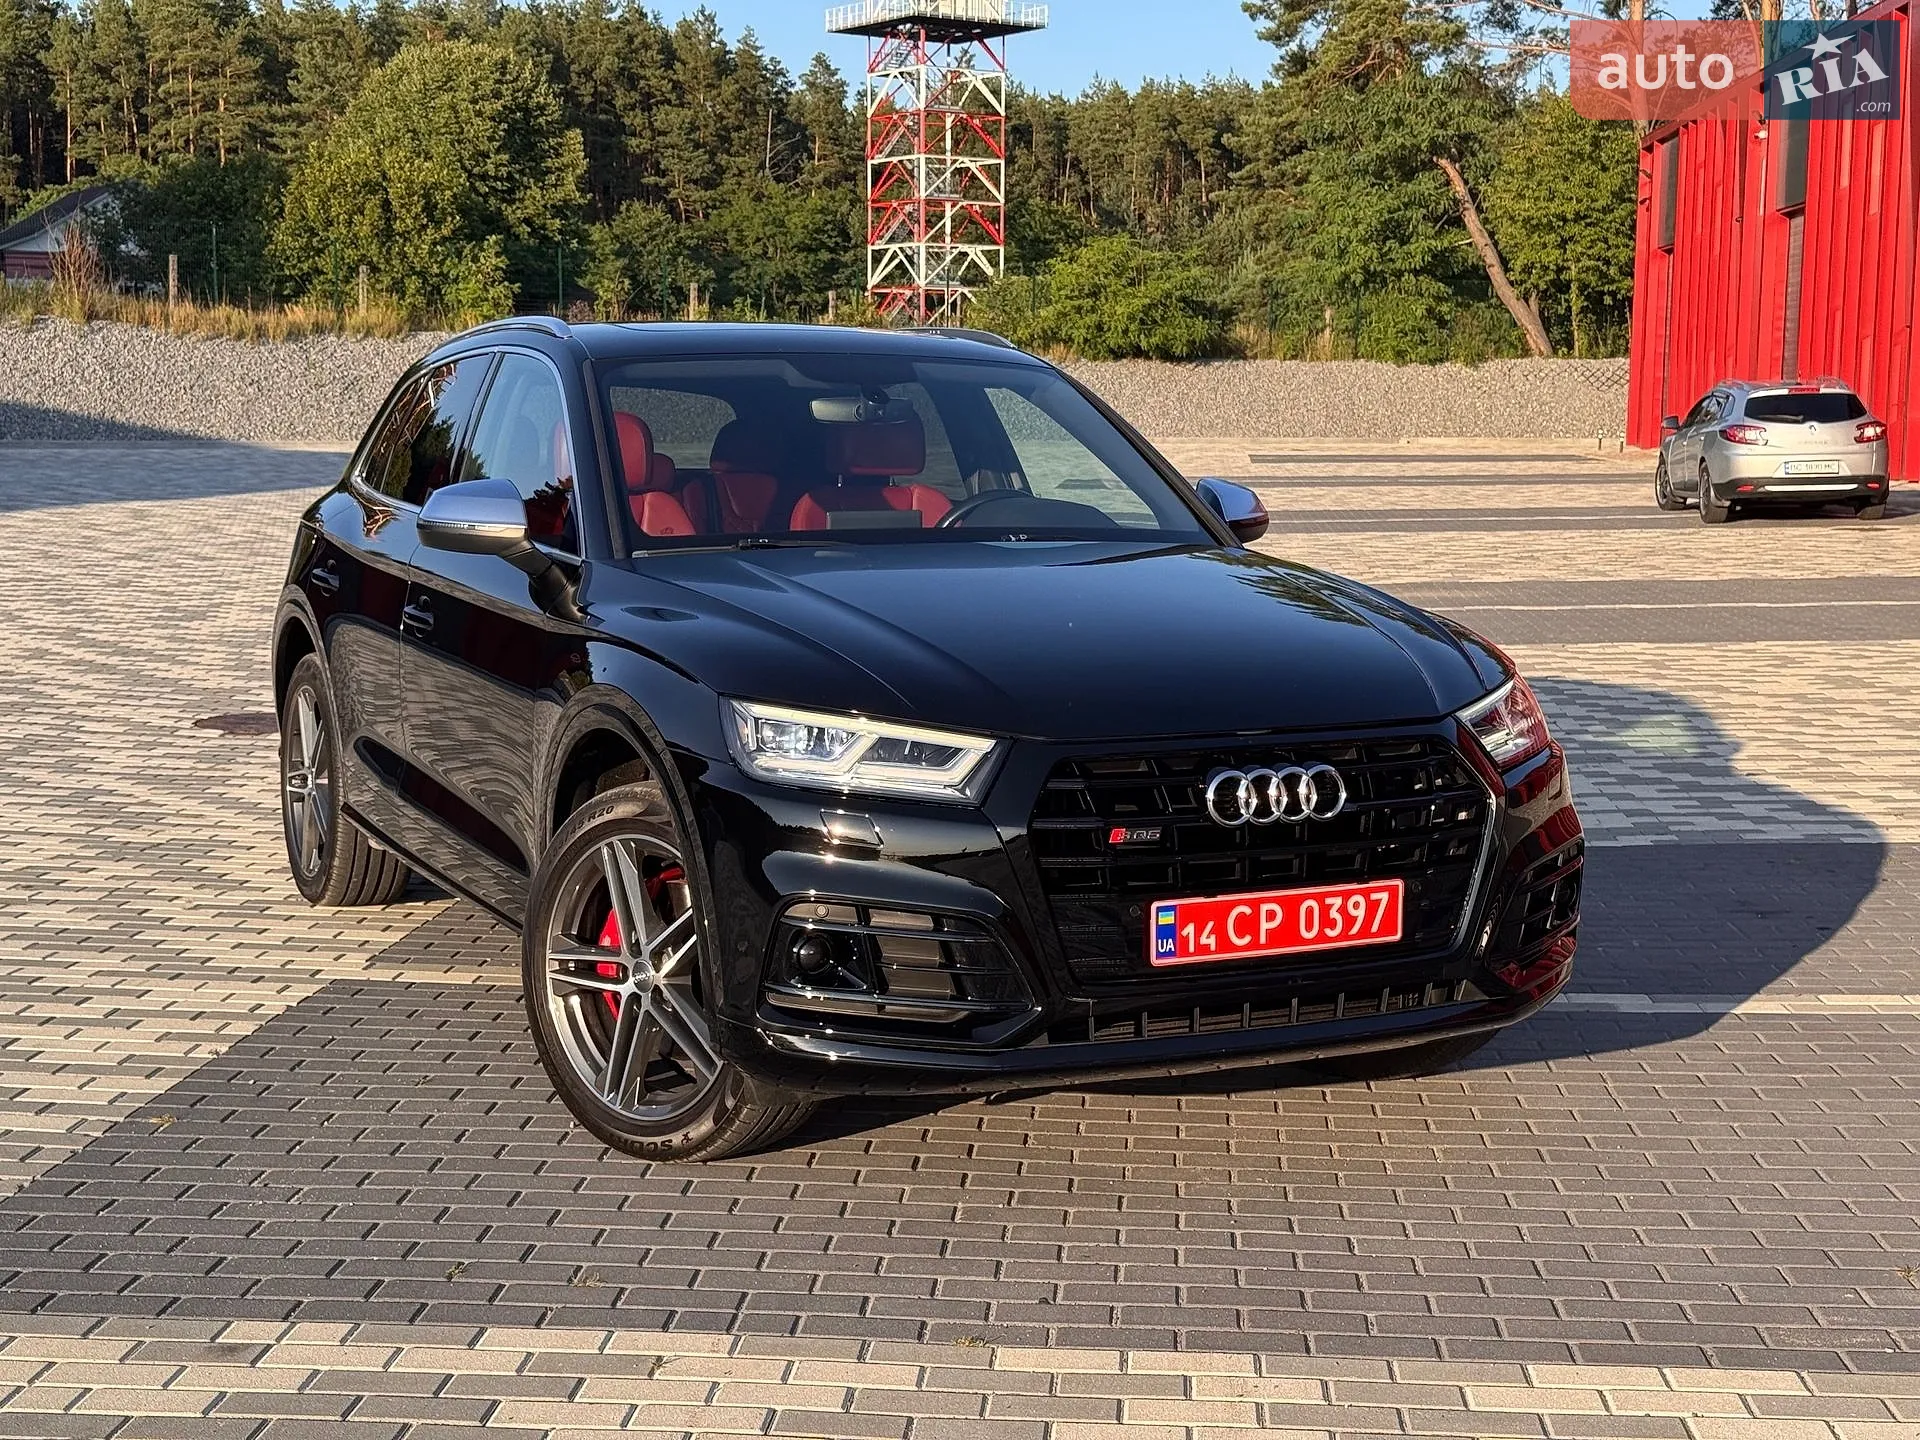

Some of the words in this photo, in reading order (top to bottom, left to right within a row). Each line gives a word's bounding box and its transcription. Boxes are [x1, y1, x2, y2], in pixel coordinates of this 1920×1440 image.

[1180, 920, 1217, 954] 14
[1226, 902, 1284, 947] CP
[1299, 891, 1390, 940] 0397
[1157, 938, 1175, 953] UA
